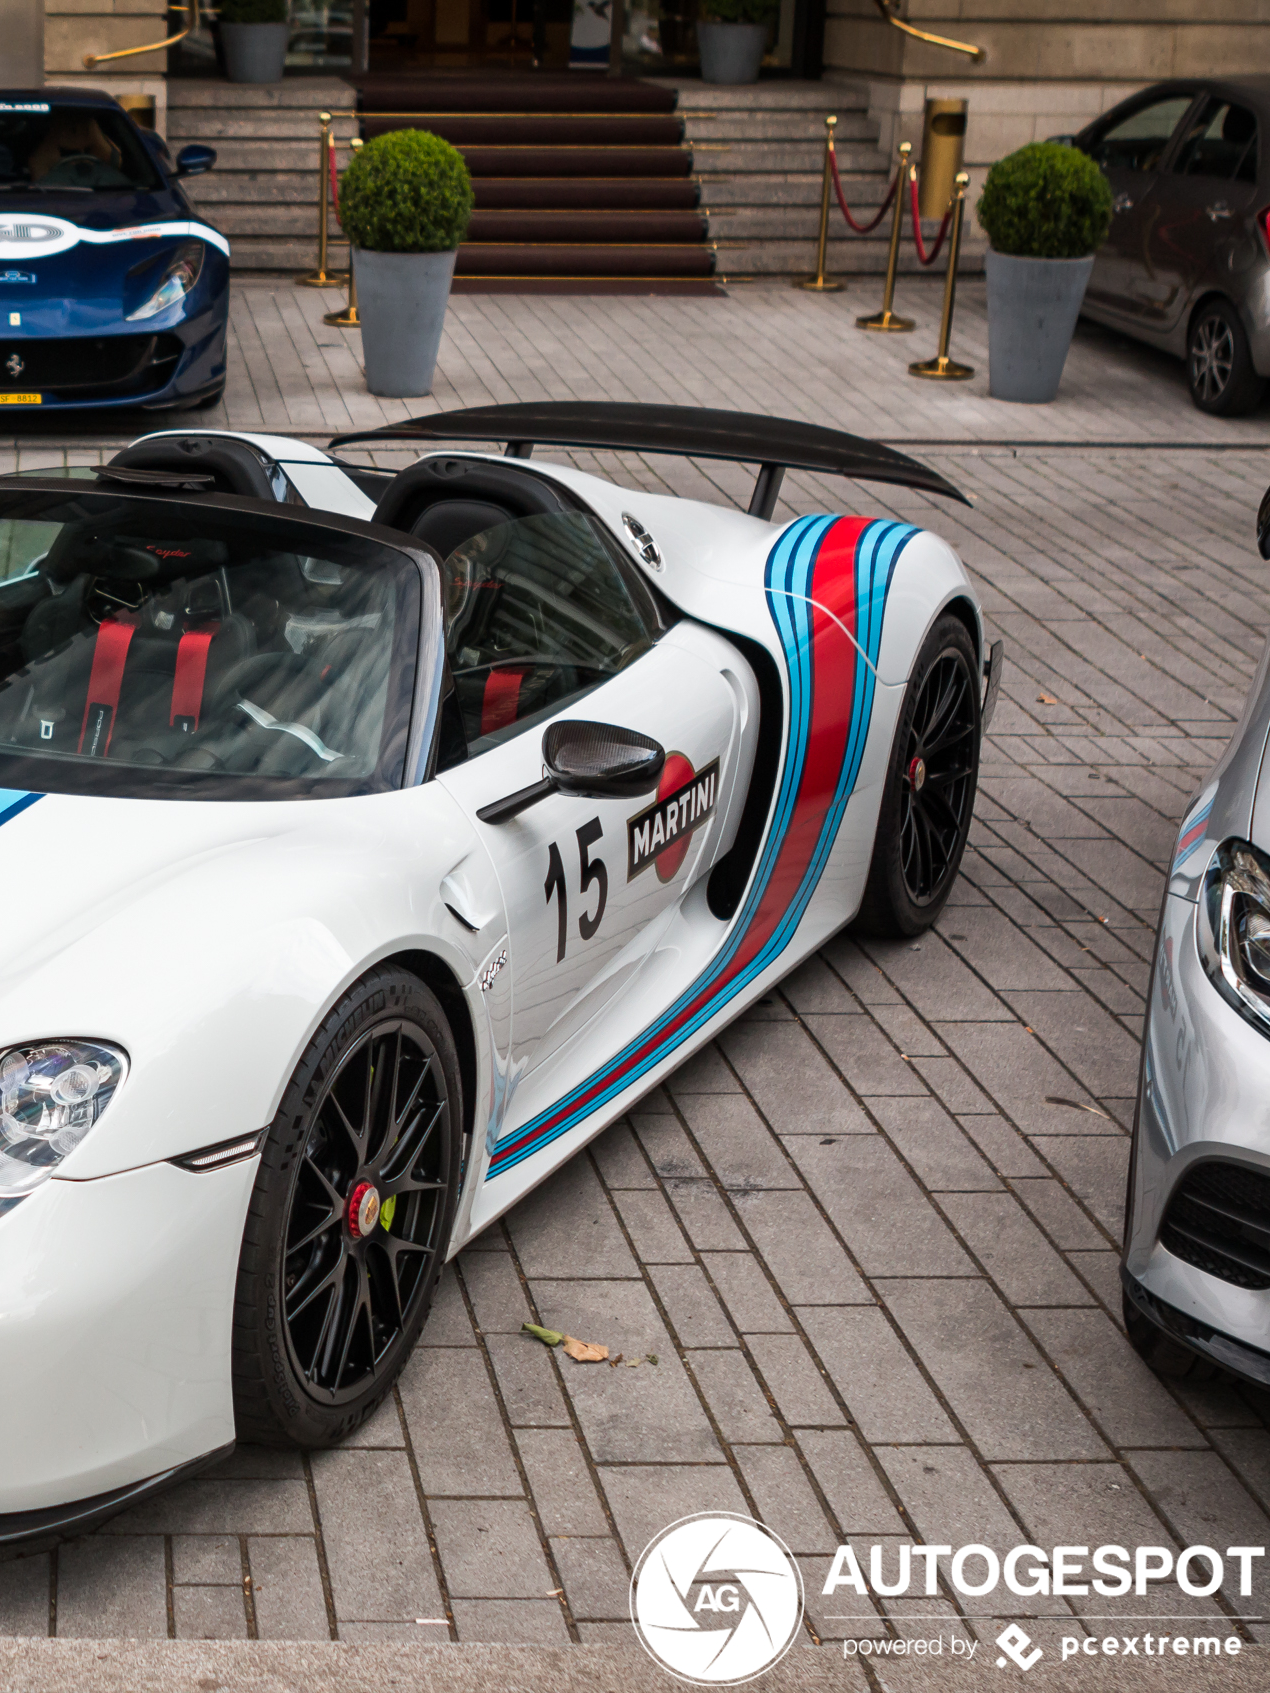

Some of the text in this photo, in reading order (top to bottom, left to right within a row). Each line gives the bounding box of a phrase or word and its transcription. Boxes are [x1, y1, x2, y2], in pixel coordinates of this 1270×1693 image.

[633, 772, 715, 865] MARTINI
[544, 815, 608, 964] 15
[319, 990, 386, 1077] MICHELIN
